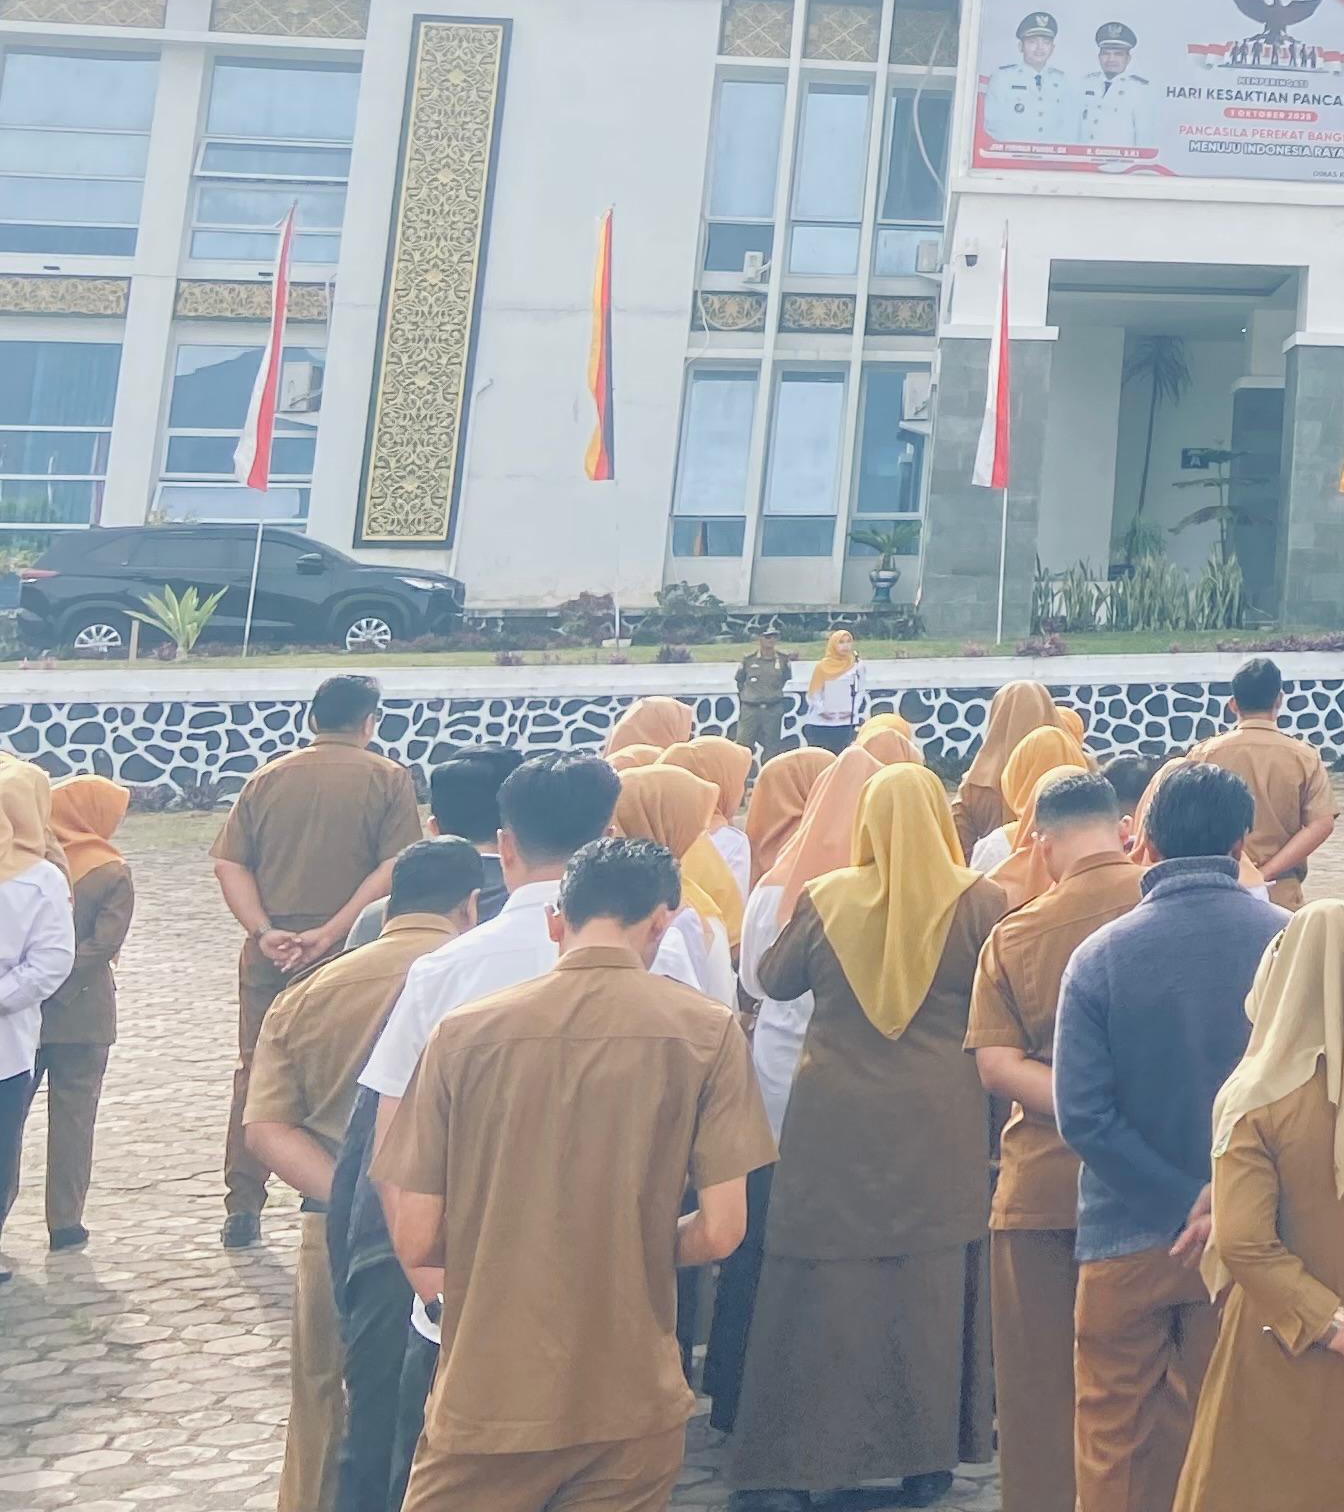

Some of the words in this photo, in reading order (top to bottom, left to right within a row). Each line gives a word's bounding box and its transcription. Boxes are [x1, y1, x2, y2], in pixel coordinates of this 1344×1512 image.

[1166, 86, 1202, 99] HARI
[1206, 88, 1289, 105] KESAKTIAN
[1237, 109, 1286, 119] OKTOBER
[1178, 124, 1249, 139] PANCASILA
[1251, 129, 1305, 141] PEREKAT
[1188, 140, 1242, 154] MENUJU
[1243, 142, 1312, 157] INDONESIA
